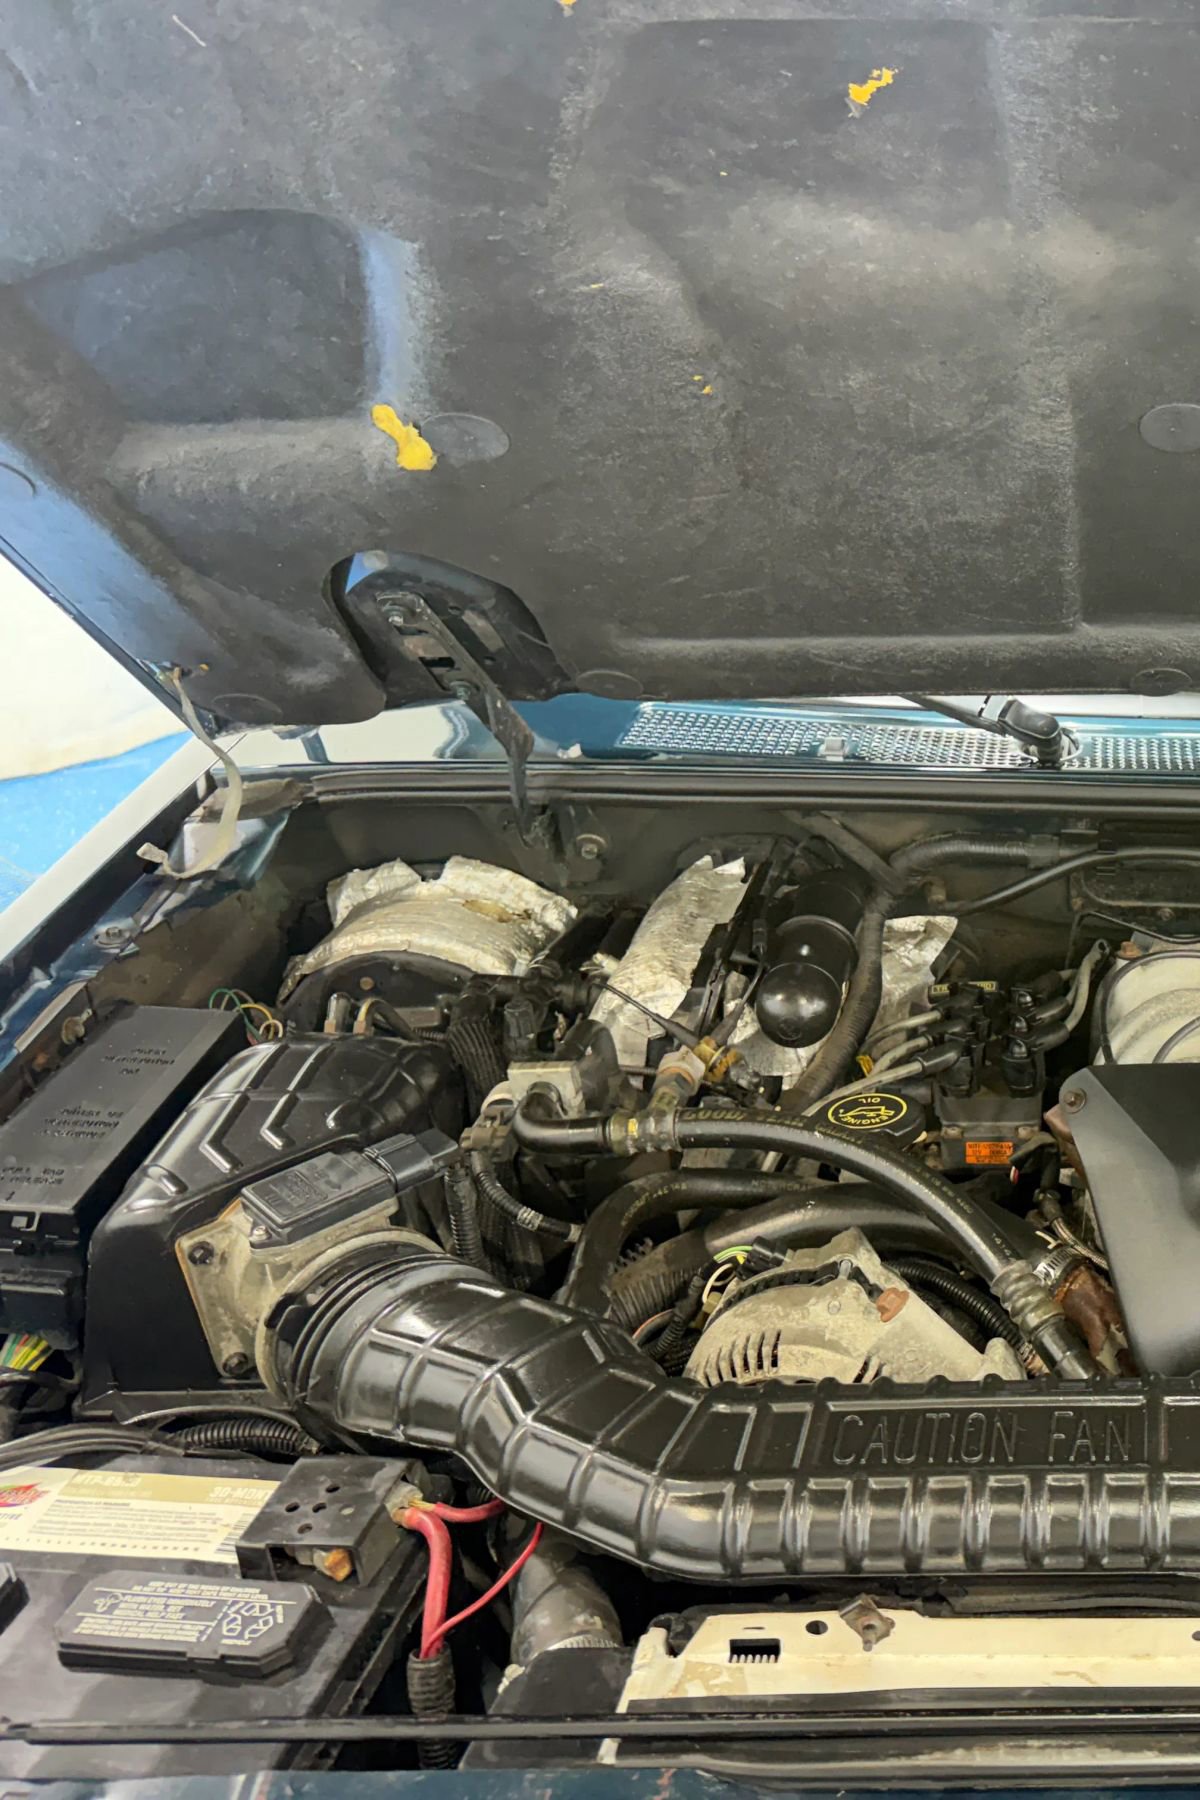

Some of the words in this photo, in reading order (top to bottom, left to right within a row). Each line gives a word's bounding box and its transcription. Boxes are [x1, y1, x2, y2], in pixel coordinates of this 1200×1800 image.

[839, 1114, 889, 1125] ENGINE
[832, 1410, 1018, 1465] CAUTION
[1048, 1410, 1130, 1463] FAN
